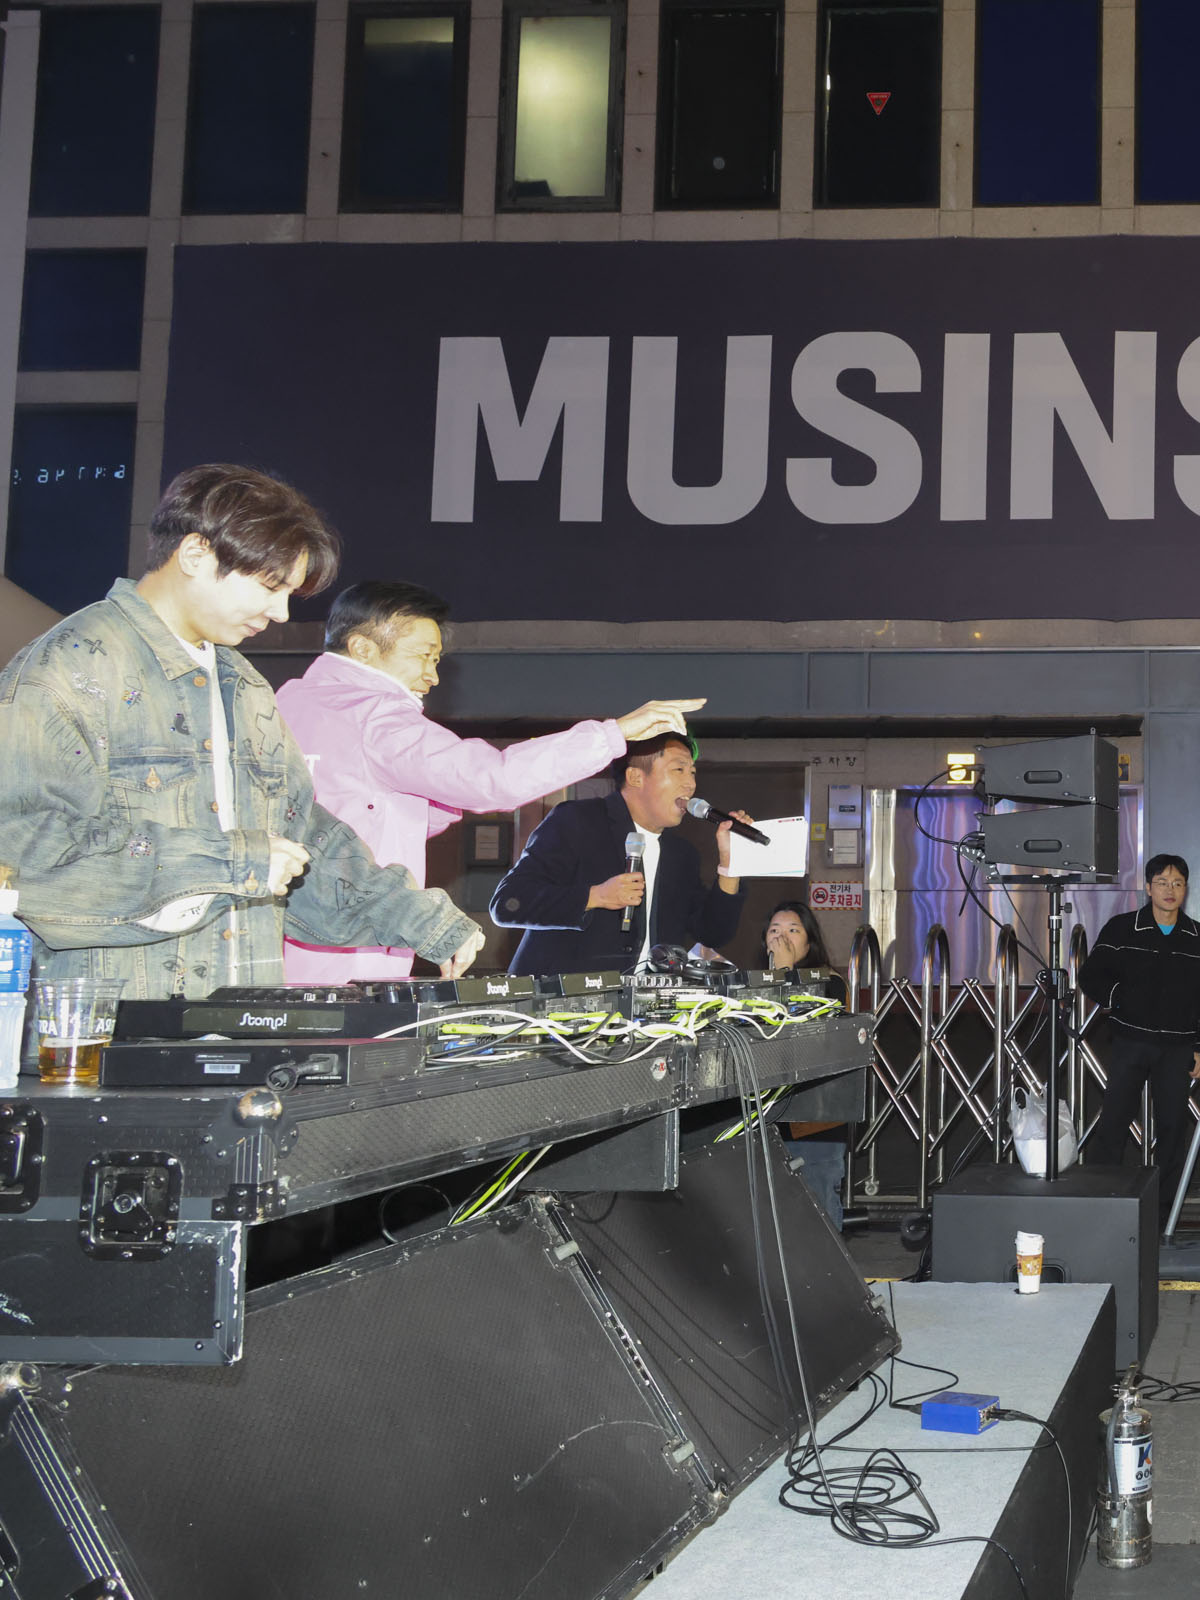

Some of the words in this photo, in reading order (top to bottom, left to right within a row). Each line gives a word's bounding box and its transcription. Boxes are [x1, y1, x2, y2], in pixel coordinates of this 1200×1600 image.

[811, 756, 857, 768] 주차장
[829, 884, 851, 894] 전기차
[829, 894, 862, 907] 주차금지
[239, 1012, 288, 1032] Stomp!
